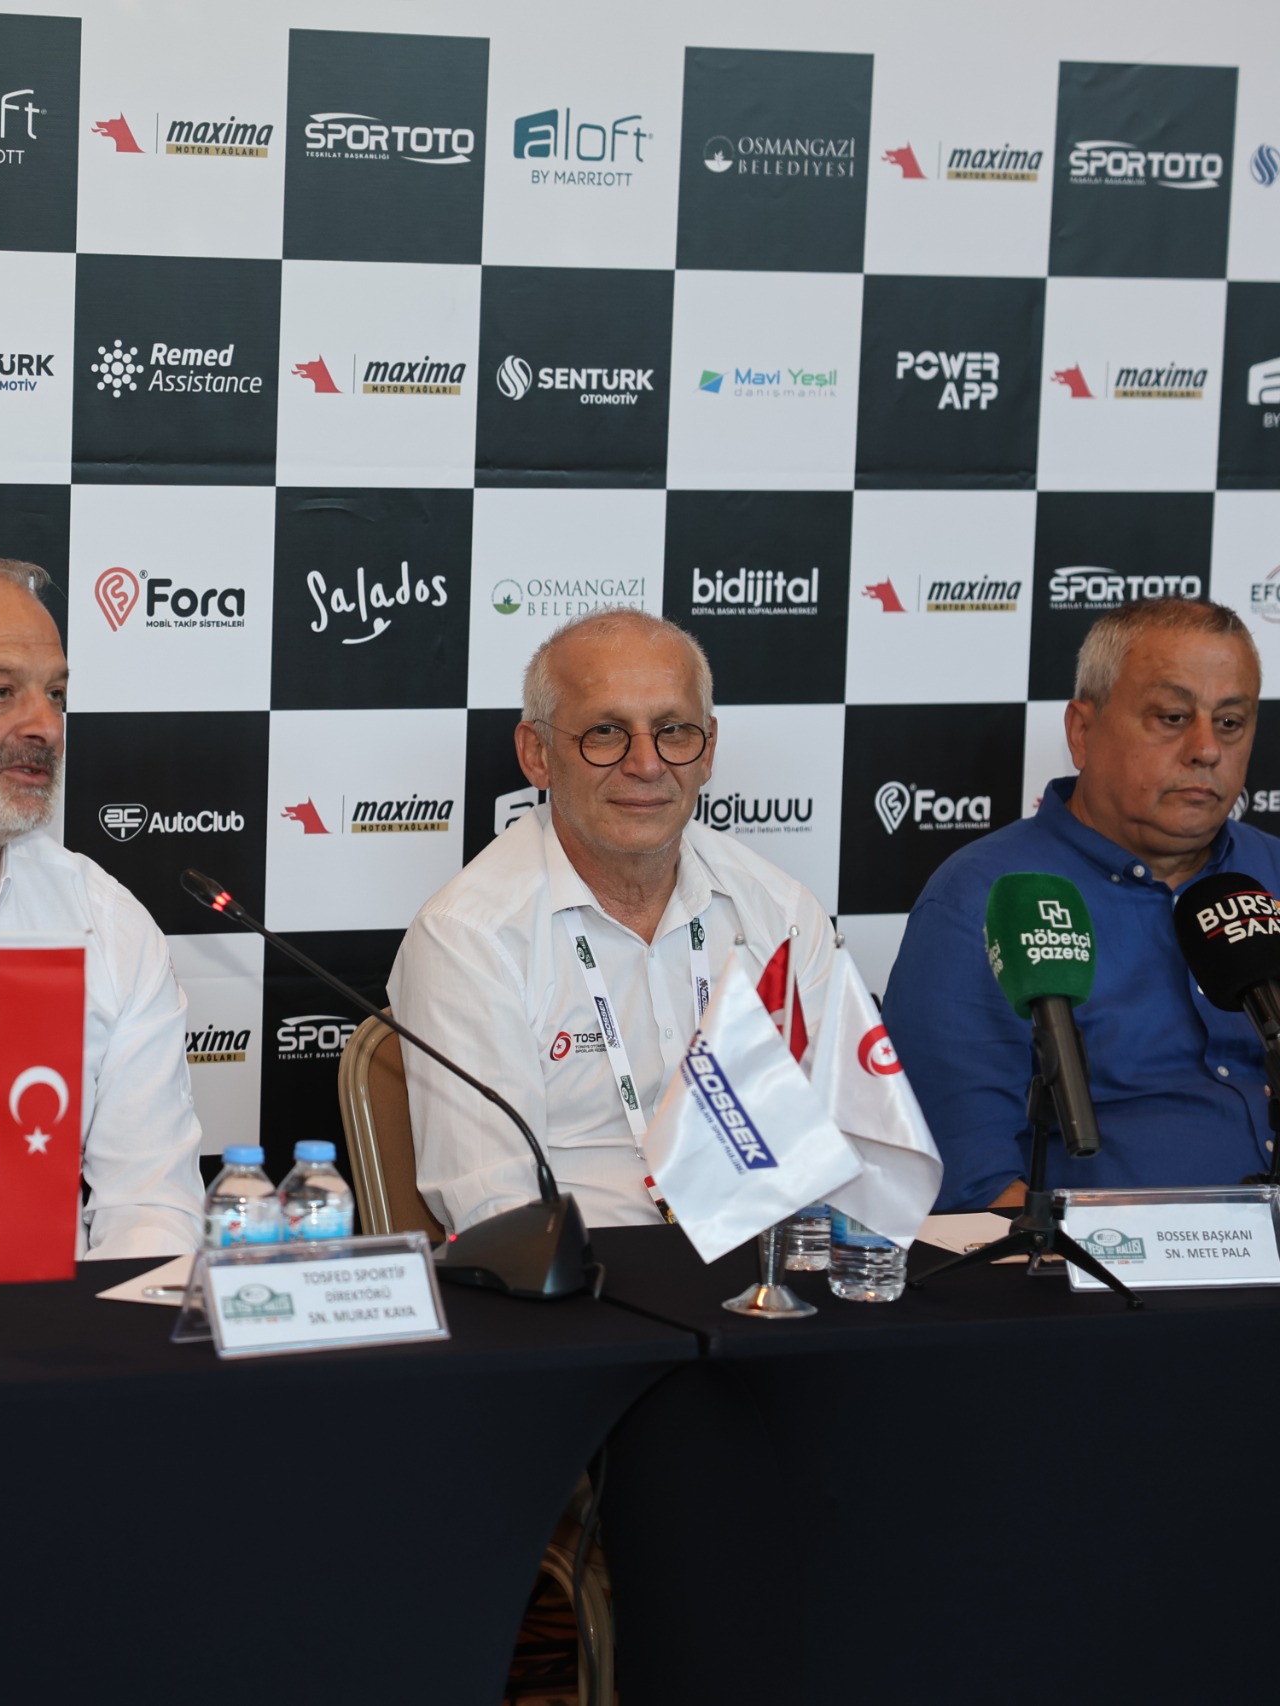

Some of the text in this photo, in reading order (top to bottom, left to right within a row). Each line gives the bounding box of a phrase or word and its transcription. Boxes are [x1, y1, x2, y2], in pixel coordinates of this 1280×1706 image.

[167, 116, 273, 146] maxima
[514, 108, 645, 162] aloft
[175, 146, 260, 157] MOTOR YAĞLARI
[738, 137, 854, 157] OSMANGAZİ
[948, 144, 1043, 170] maxima
[532, 170, 632, 186] BY MARRIOTT
[739, 159, 853, 176] BELEDİYESİ
[150, 343, 234, 366] Remed
[897, 351, 999, 380] POWER
[149, 370, 262, 393] Assistance
[364, 356, 466, 385] maxima
[735, 368, 837, 387] Mavi Yeşil
[1115, 363, 1208, 388] maxima
[372, 386, 453, 394] MOTOR YAĞLARI
[580, 392, 637, 404] OTOMOTİV
[938, 382, 998, 409] APP
[147, 579, 245, 617] Fora
[306, 560, 448, 633] Salados
[527, 578, 644, 596] OSMANGAZİ
[691, 567, 820, 607] bidijital
[928, 575, 1021, 600] maxima
[174, 619, 197, 627] TAKİP
[200, 619, 244, 627] SİSTEMLERİ
[352, 794, 454, 823] maxima
[914, 789, 990, 821] Fora
[147, 811, 244, 833] AutoClub
[360, 821, 441, 832] MOTOR YAĞLARI
[1021, 928, 1091, 949] nöbetçi
[1026, 945, 1090, 965] gazete
[193, 1053, 237, 1063] YAĞLARI
[689, 1054, 768, 1164] BOSSEK
[1156, 1229, 1253, 1244] BOSSEK BAŞKANI
[1165, 1247, 1252, 1260] SN. METE PALA
